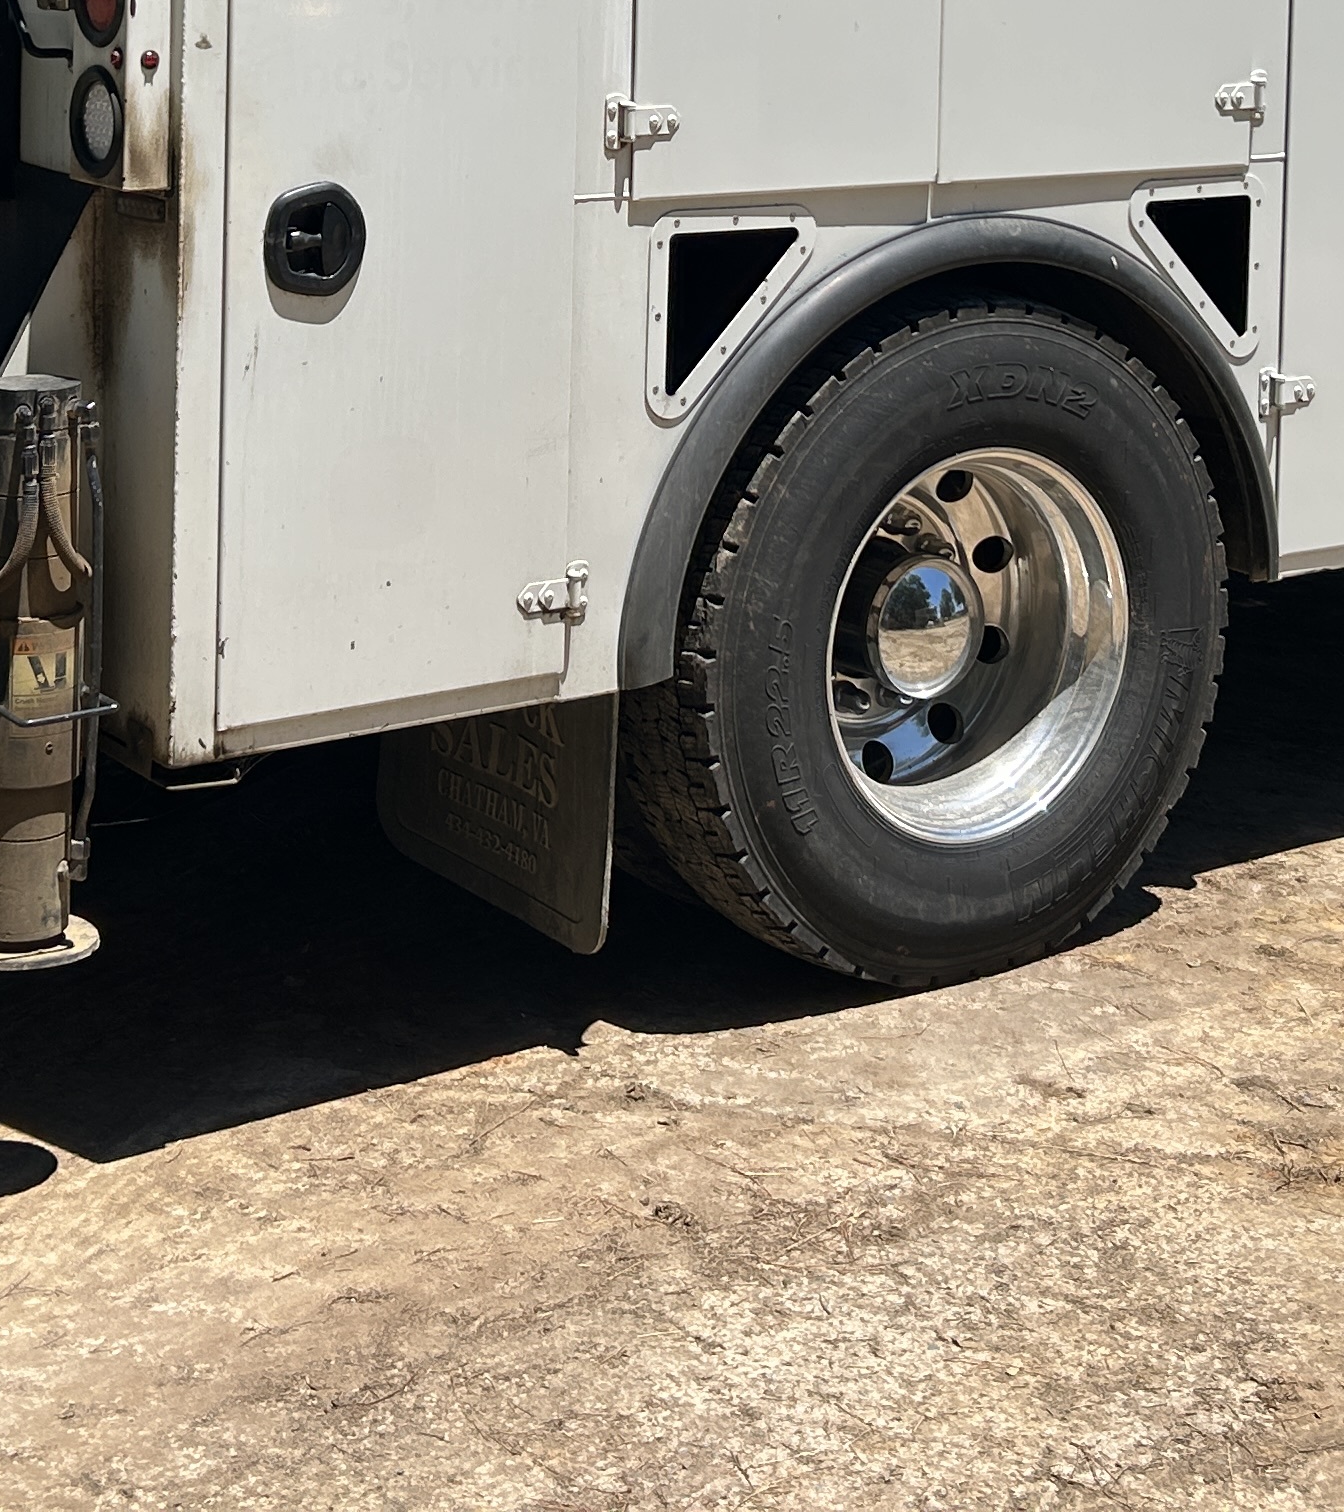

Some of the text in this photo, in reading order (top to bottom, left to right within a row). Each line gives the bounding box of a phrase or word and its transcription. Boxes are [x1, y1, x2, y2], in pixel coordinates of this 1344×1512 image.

[947, 361, 1099, 420] XDN2
[429, 717, 559, 809] SALES
[764, 614, 820, 835] 11R22.5
[437, 766, 553, 851] CHATHAM, VA
[1016, 674, 1190, 924] MICHELIN
